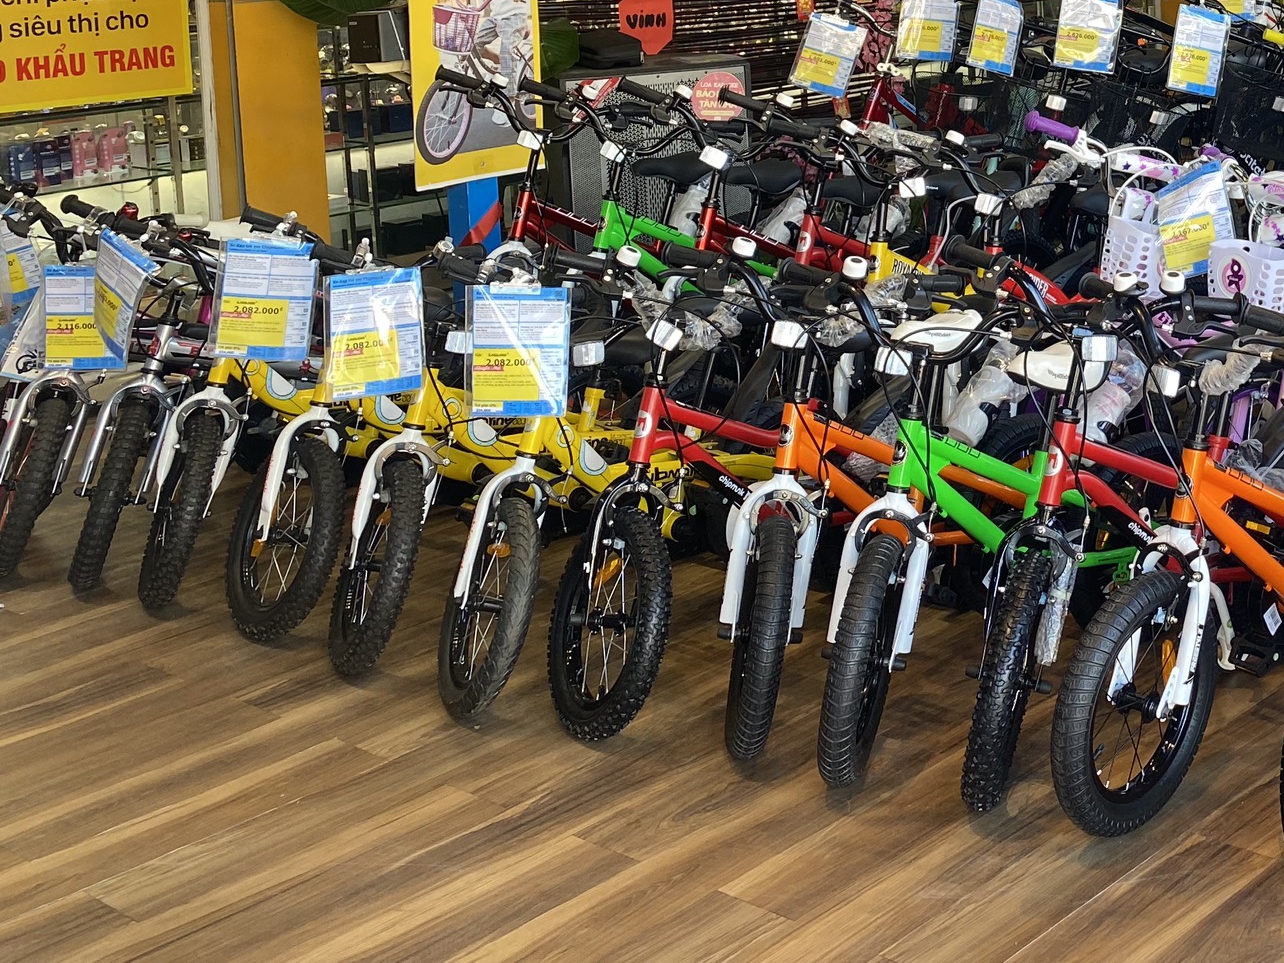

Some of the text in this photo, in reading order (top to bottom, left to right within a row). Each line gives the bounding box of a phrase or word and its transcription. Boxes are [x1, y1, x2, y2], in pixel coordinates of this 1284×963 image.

[9, 11, 149, 39] siêu thị cho
[16, 43, 176, 82] KHẨU TRANG
